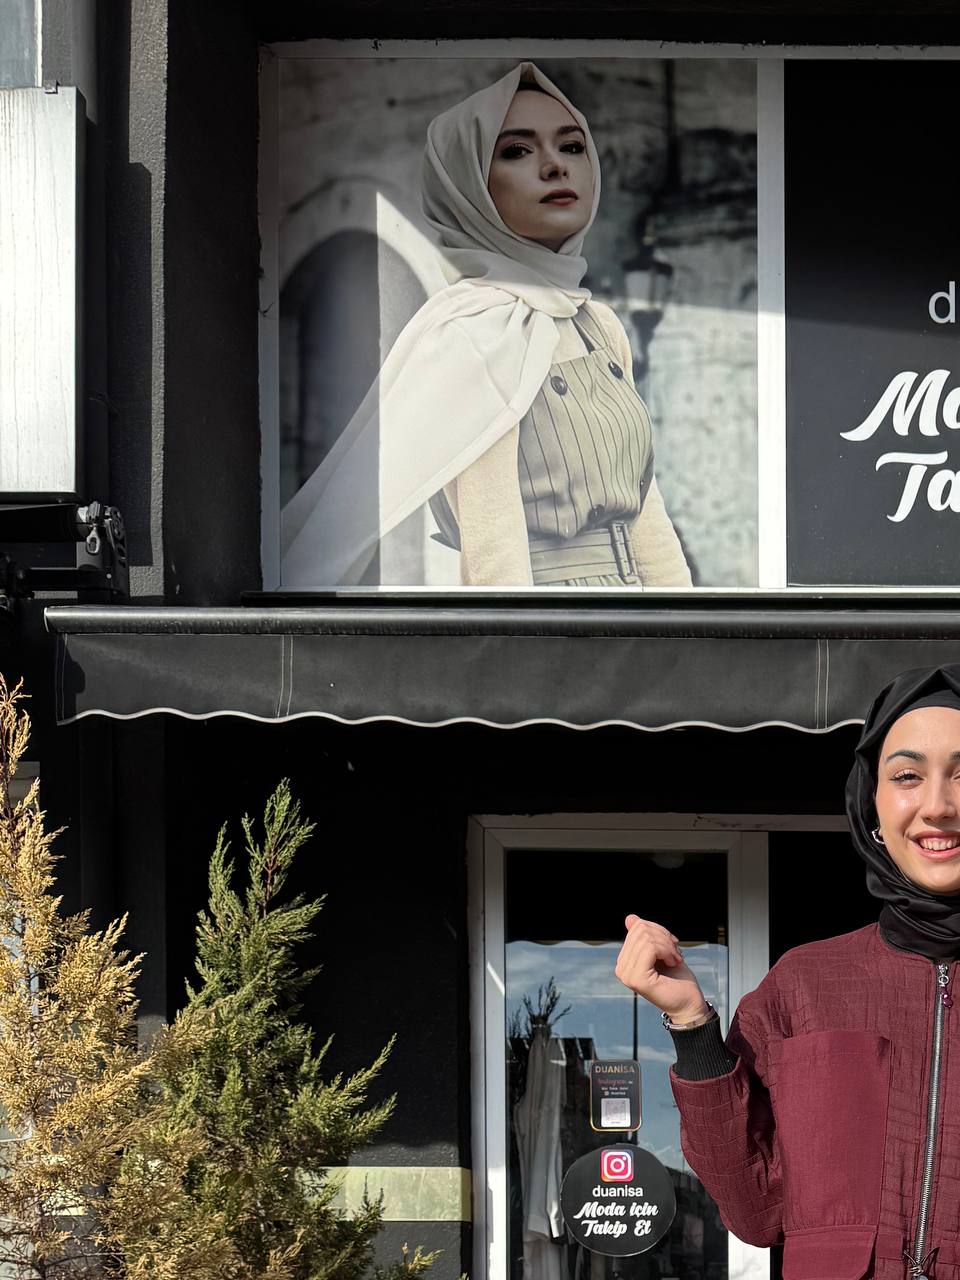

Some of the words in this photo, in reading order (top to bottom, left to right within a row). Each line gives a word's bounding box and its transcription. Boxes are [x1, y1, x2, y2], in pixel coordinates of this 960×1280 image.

[592, 1184, 643, 1197] duanisa
[573, 1201, 626, 1219] Moda
[629, 1202, 659, 1218] için
[581, 1219, 627, 1238] Takip
[633, 1219, 652, 1237] Et
